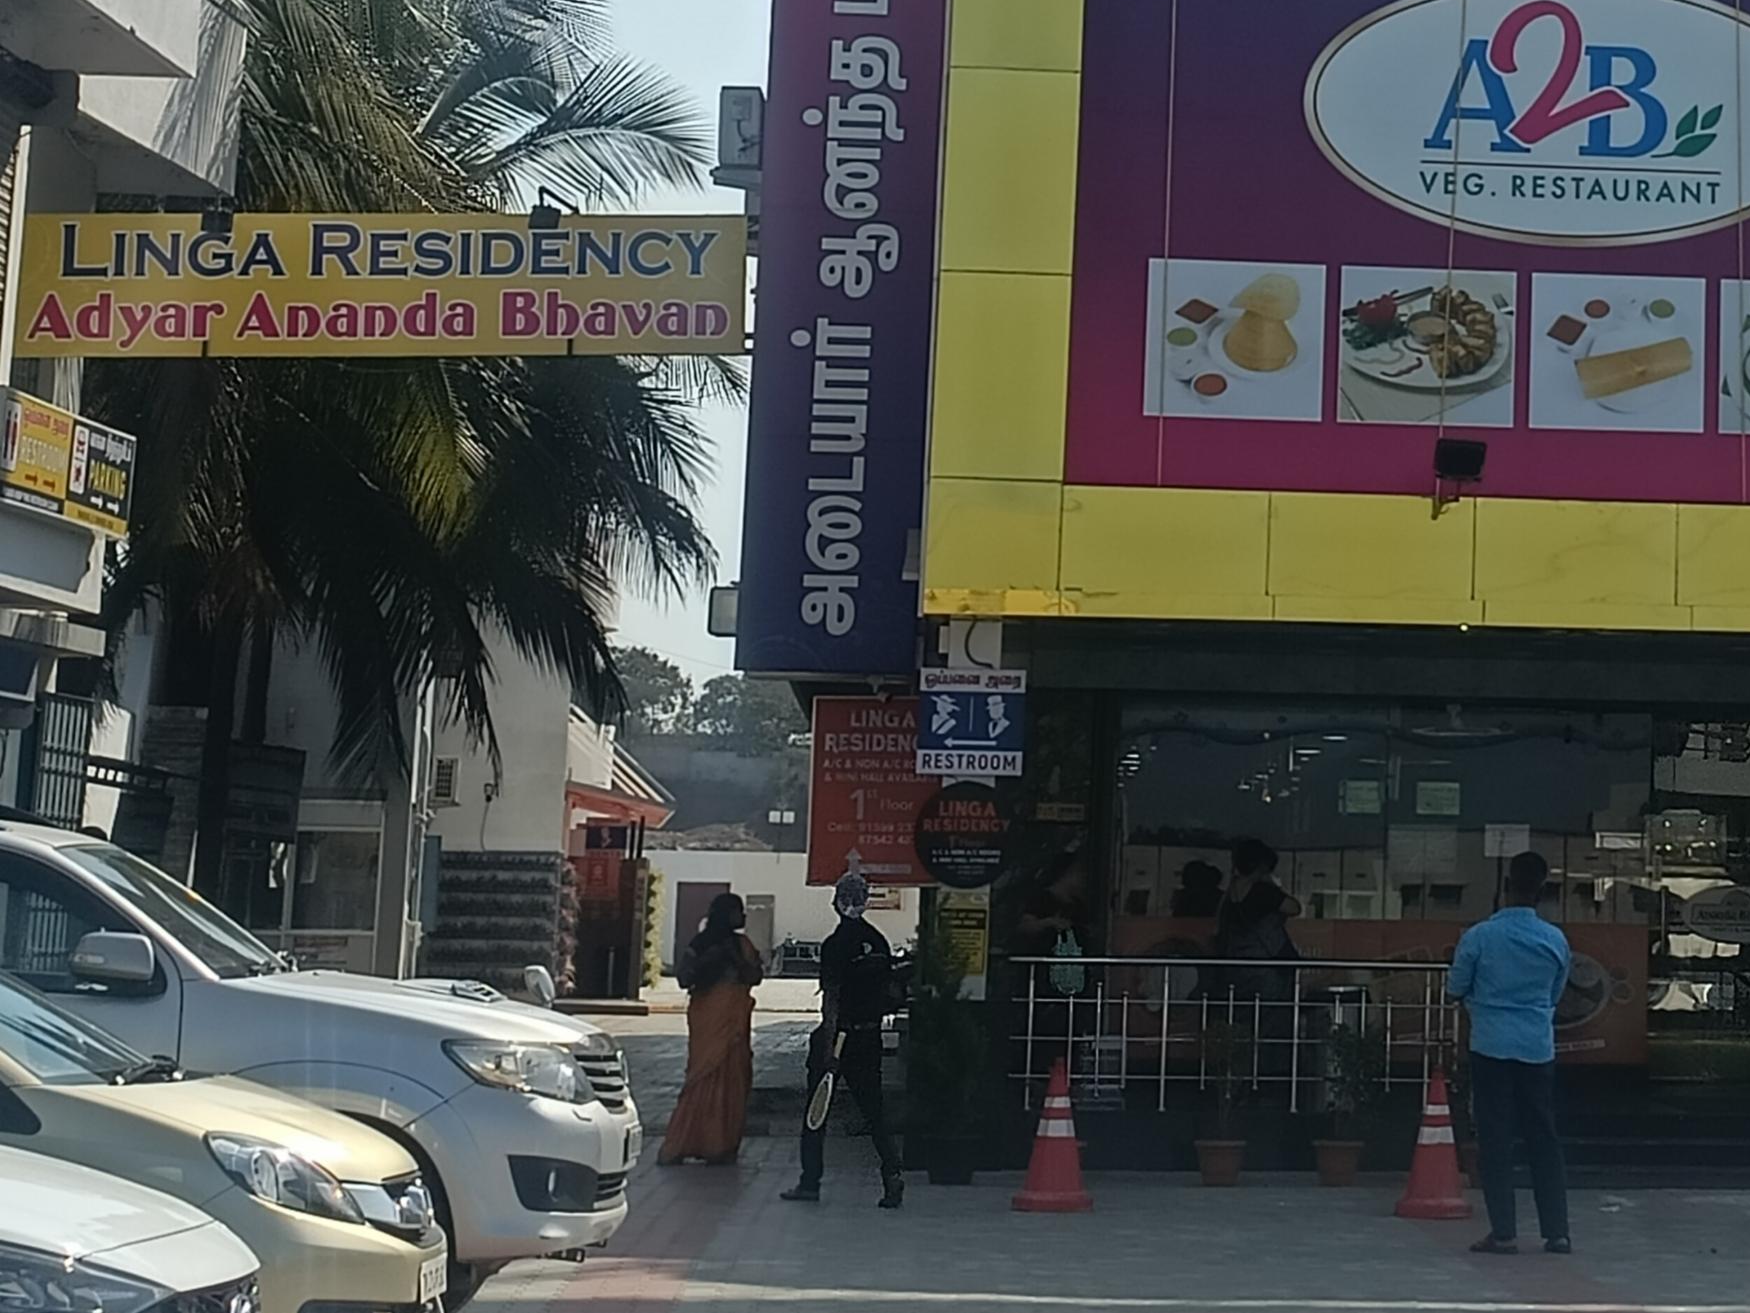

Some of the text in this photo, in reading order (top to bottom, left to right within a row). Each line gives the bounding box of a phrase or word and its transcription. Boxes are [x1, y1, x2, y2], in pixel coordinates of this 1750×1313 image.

[802, 35, 907, 299] ஆனந்த
[1419, 170, 1722, 205] VEG. RESTAURANT
[60, 222, 720, 278] LINGA RESIDENCY
[27, 290, 730, 349] Adyar Ananda Bhavan
[790, 316, 872, 636] அடையார்
[851, 710, 916, 728] LINGA
[824, 734, 919, 753] RESIDEN
[922, 753, 1016, 770] RESTROOM
[939, 800, 996, 817] LINGA
[923, 818, 1010, 833] RESIDENCY
